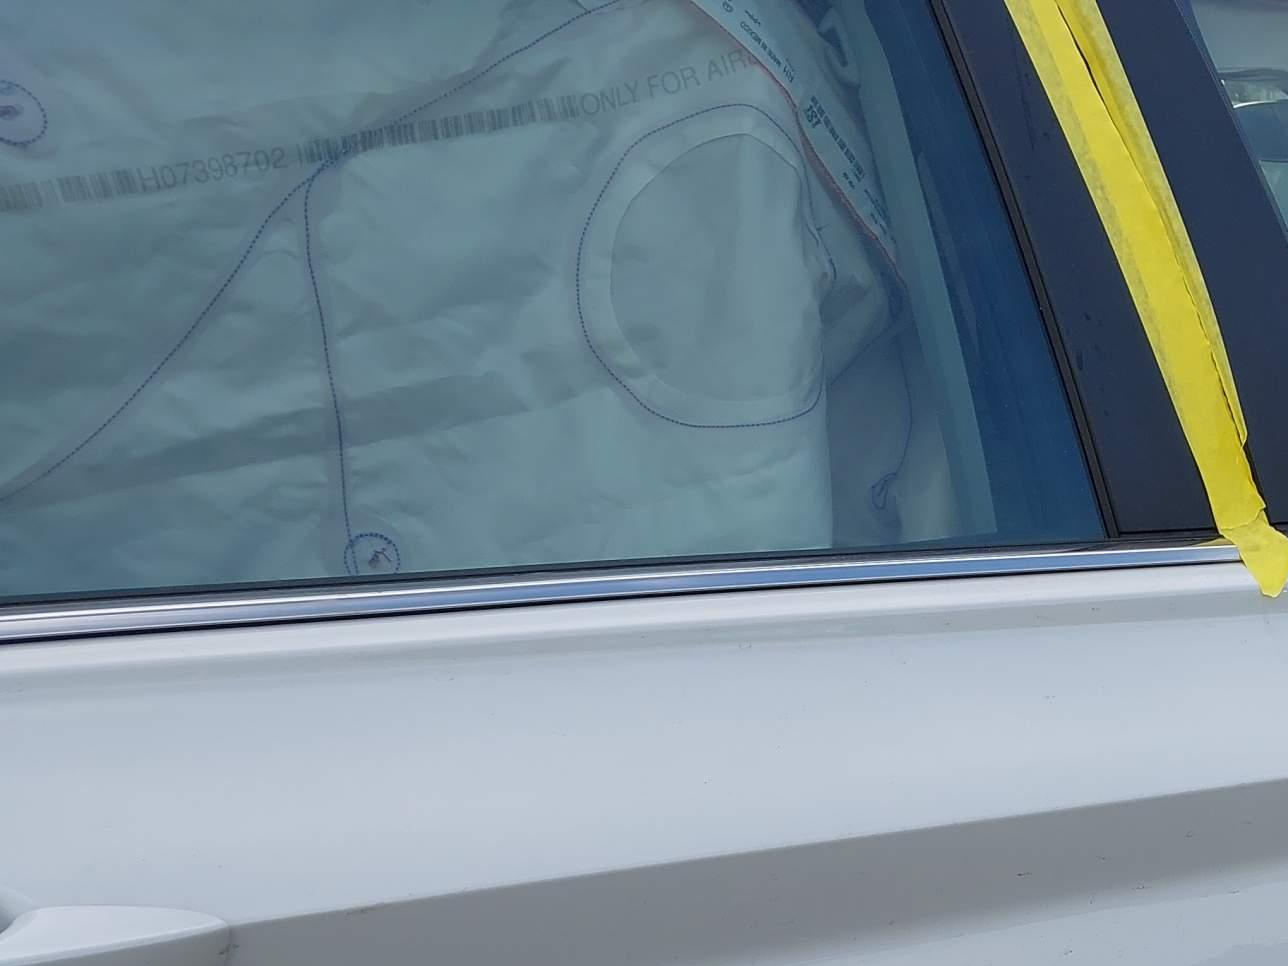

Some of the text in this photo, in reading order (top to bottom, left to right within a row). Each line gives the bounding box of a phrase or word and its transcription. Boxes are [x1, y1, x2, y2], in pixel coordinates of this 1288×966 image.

[581, 80, 639, 116] ONLY
[648, 67, 701, 98] FOR
[136, 147, 288, 193] H07398702
